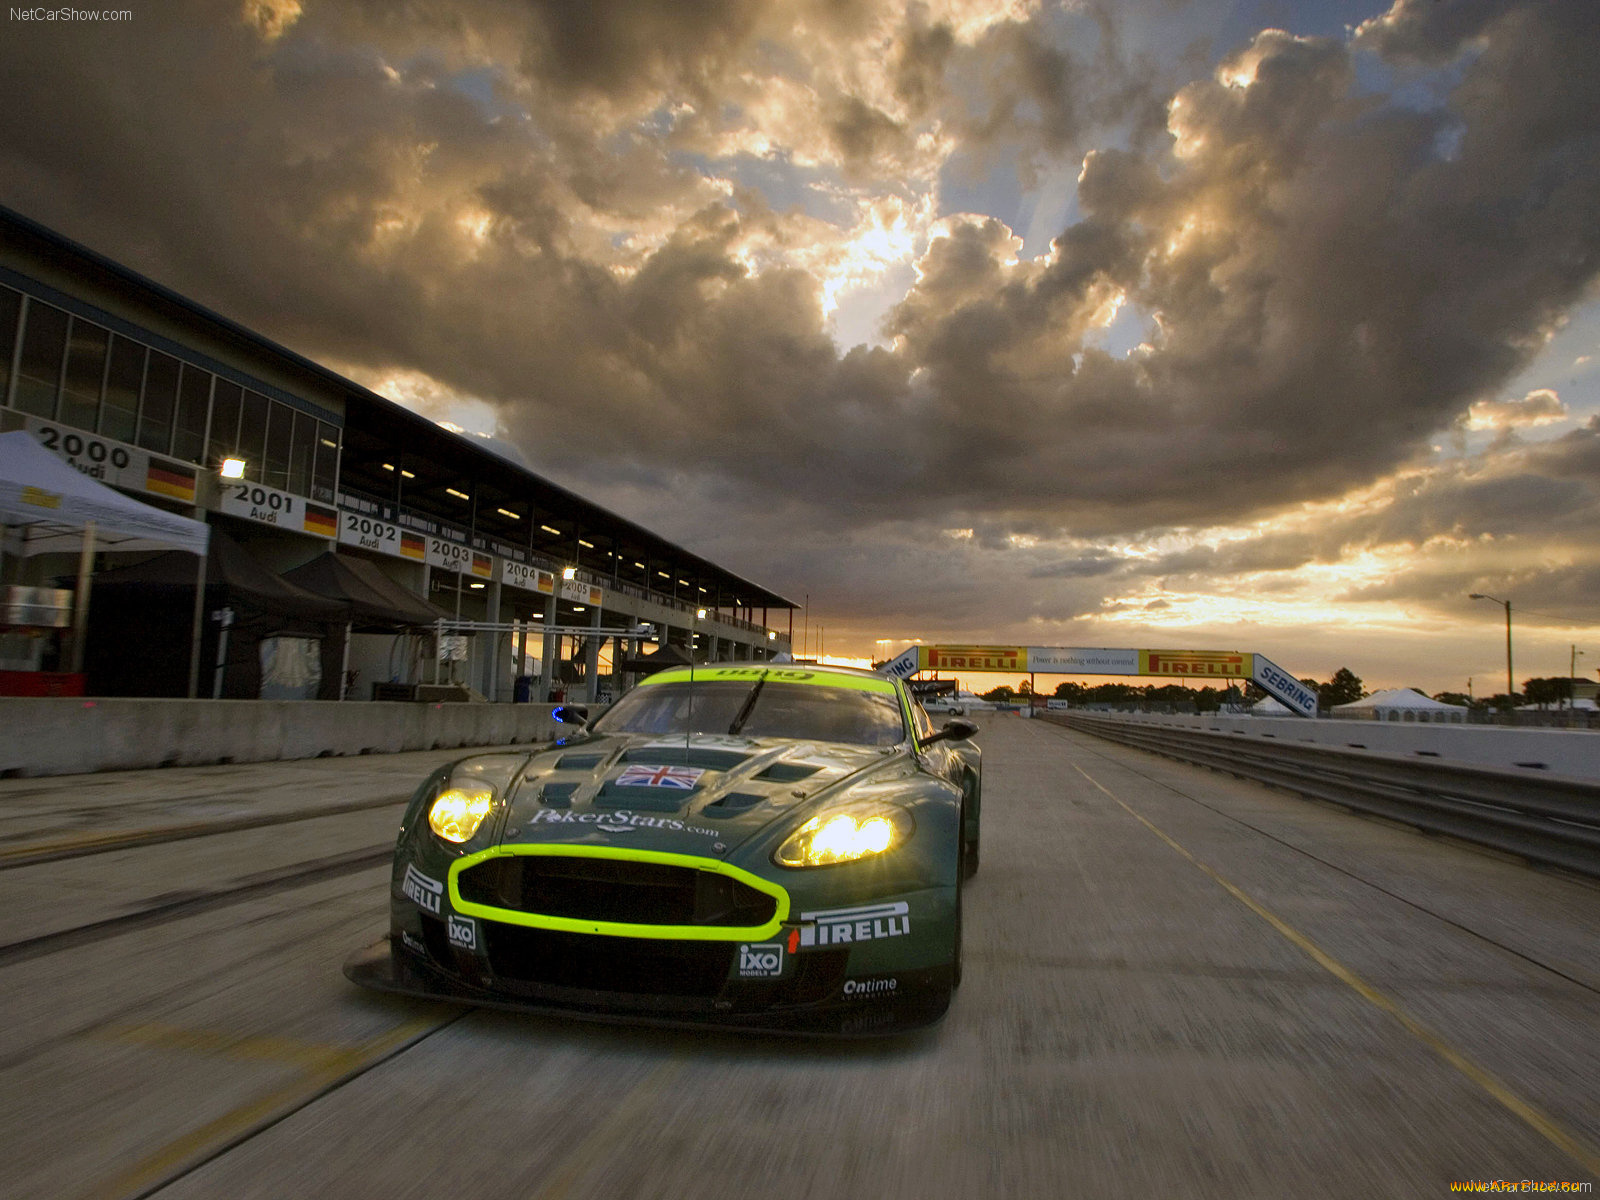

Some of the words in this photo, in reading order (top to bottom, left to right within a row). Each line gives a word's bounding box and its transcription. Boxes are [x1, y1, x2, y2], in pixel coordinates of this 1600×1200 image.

[39, 427, 129, 469] 2000
[67, 457, 105, 480] Audi
[234, 485, 293, 514] 2001
[250, 507, 277, 524] Audi
[347, 515, 396, 541] 2002
[359, 536, 380, 549] Audi
[432, 541, 469, 561] 2003
[443, 558, 459, 570] Au
[507, 563, 536, 580] 2004
[566, 582, 588, 594] 2005
[886, 658, 914, 677] ING
[928, 649, 1018, 668] PIRELLI
[1060, 656, 1085, 666] nothing
[1085, 657, 1111, 666] without
[1149, 654, 1243, 675] PIRELLI
[1261, 667, 1315, 711] SEBRING
[402, 863, 443, 915] PIRELLI
[800, 901, 911, 947] PIRELLI
[843, 978, 897, 995] Ontime
